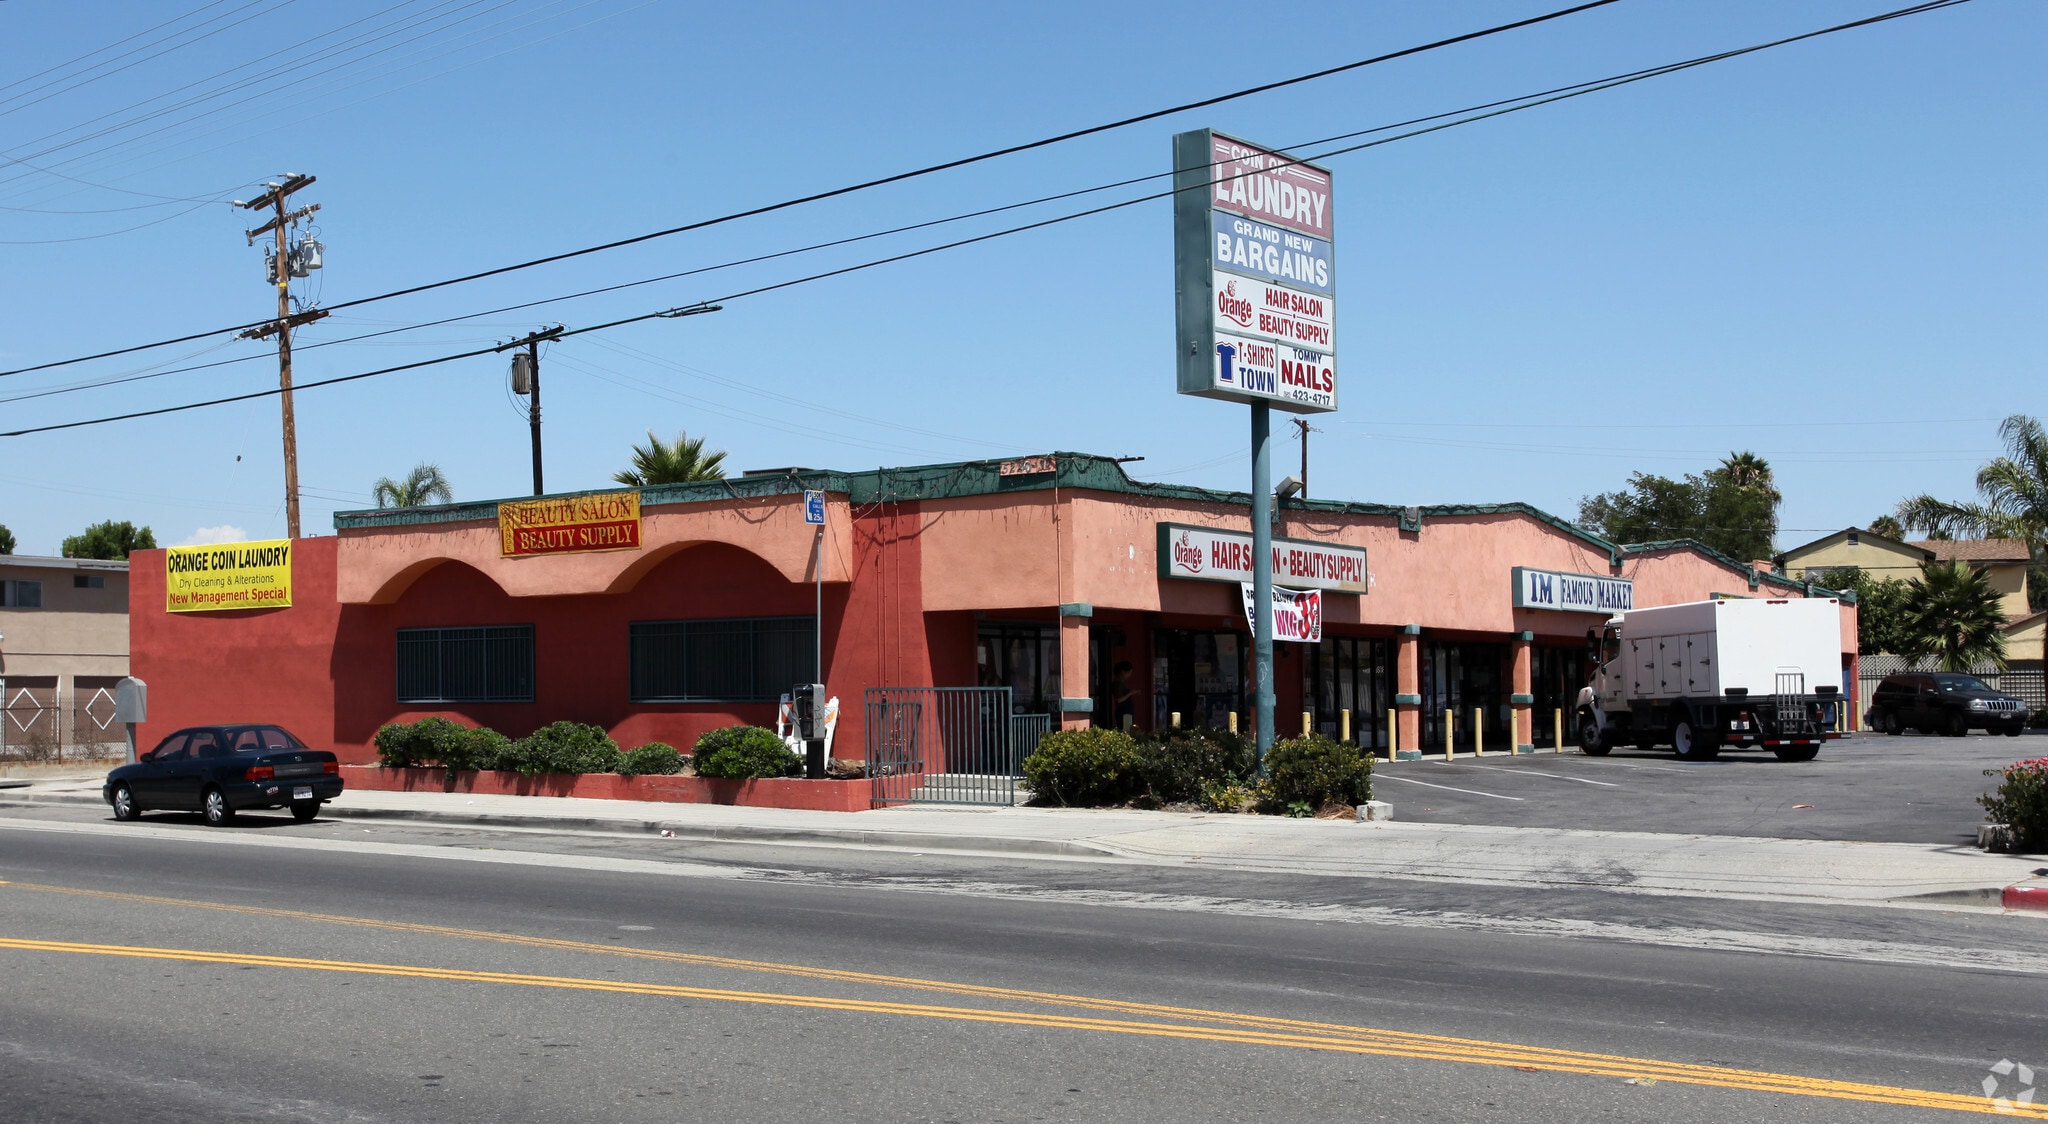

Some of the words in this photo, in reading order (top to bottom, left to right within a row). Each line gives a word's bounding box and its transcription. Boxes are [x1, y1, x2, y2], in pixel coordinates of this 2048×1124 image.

[1231, 145, 1263, 170] COIN
[1268, 157, 1288, 176] OP
[1215, 160, 1326, 229] LAUNDRY
[1234, 220, 1280, 243] GRAND
[1284, 234, 1313, 253] NEW
[1217, 232, 1328, 287] BARGAINS
[1218, 290, 1252, 323] Orange
[1265, 287, 1290, 310] HAIR
[1291, 294, 1323, 318] SALON
[1259, 313, 1294, 338] BEAUTY
[1295, 321, 1329, 346] SUPPLY
[1238, 342, 1274, 369] T-SHIRTS
[1293, 349, 1322, 365] TOMMY
[1239, 367, 1275, 393] TOWN
[1281, 359, 1333, 393] NAILS
[519, 503, 577, 525] BEAUTY
[581, 499, 632, 521] SALON
[519, 528, 575, 550] BEAUTY
[580, 524, 633, 546] SUPPLY
[168, 552, 209, 573] ORANGE
[211, 550, 236, 571] COIN
[238, 546, 289, 569] LAUNDRY
[1174, 540, 1203, 568] Orange
[1211, 540, 1241, 571] HAIR
[1289, 550, 1328, 579] BEAUTY
[1327, 556, 1363, 583] SUPPLY
[169, 593, 188, 604] New
[191, 589, 249, 605] Management
[251, 586, 287, 602] Special
[179, 578, 191, 590] Dry
[194, 576, 225, 588] Cleaning
[227, 575, 233, 586] &
[234, 574, 275, 585] Alterations
[1530, 572, 1553, 604] IM
[1562, 579, 1593, 605] FAMOUS
[1598, 582, 1632, 610] MARKET
[1273, 609, 1298, 637] WIG
